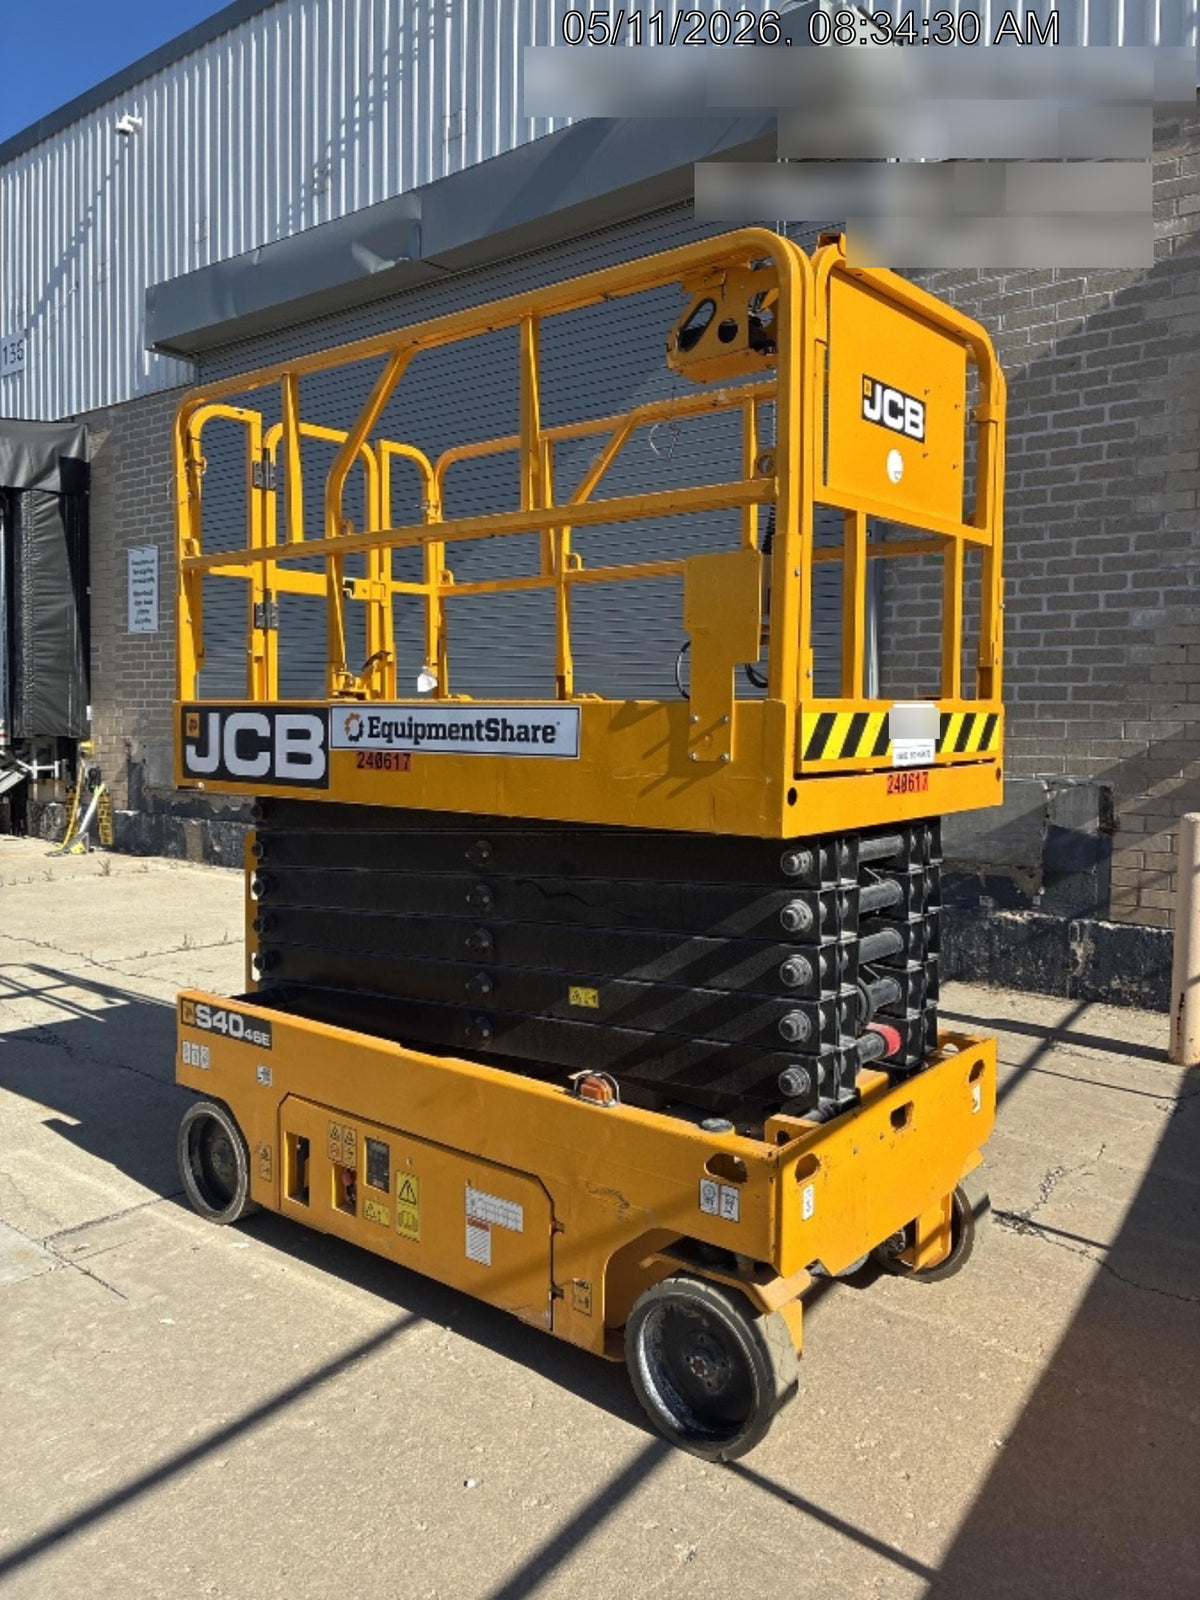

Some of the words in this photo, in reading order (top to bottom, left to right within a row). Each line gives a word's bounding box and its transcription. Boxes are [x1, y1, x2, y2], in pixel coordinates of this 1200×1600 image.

[863, 383, 924, 439] JCB
[367, 716, 557, 745] EquipmentShare
[185, 712, 326, 780] JCB
[357, 751, 411, 770] 240617
[887, 771, 928, 794] 240617
